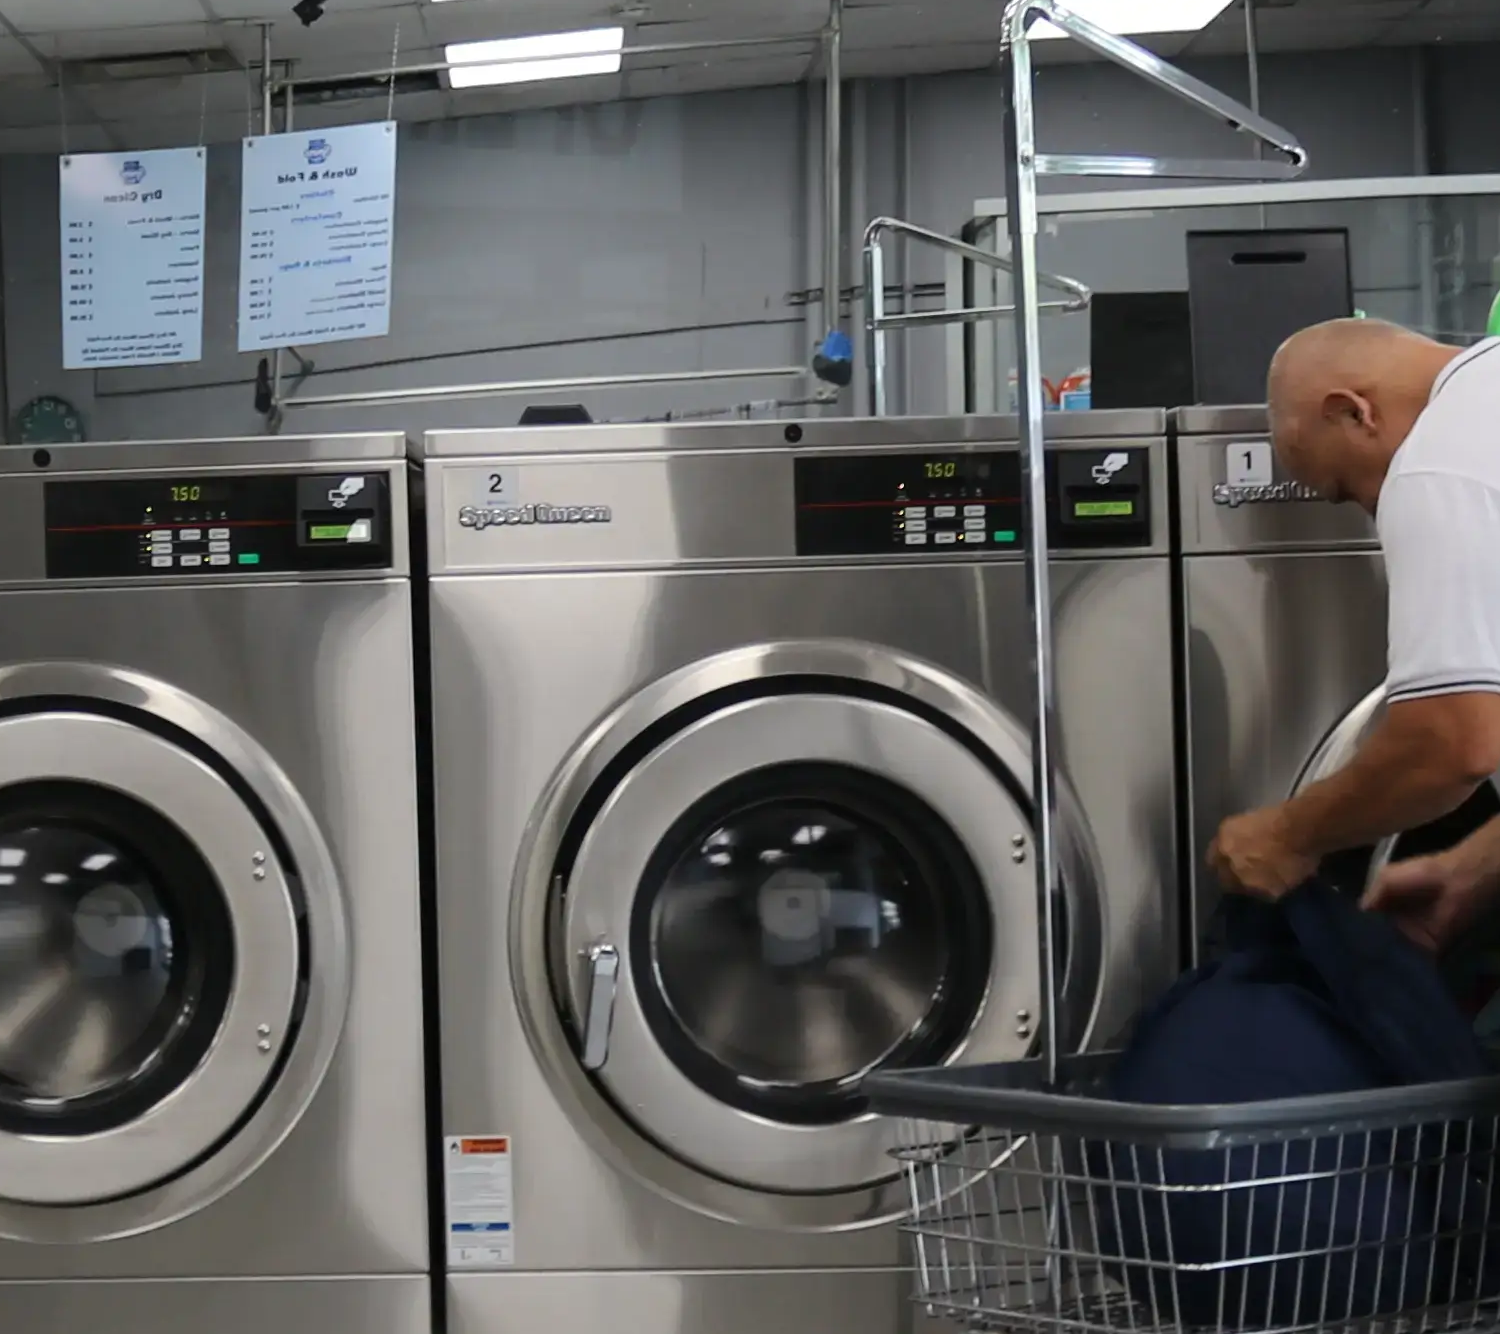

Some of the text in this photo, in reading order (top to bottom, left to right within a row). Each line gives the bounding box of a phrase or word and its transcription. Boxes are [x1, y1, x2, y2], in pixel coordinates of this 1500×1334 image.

[1243, 451, 1252, 469] 1
[489, 474, 502, 492] 2
[1213, 482, 1288, 506] Speed
[459, 502, 611, 528] Speed Queen
